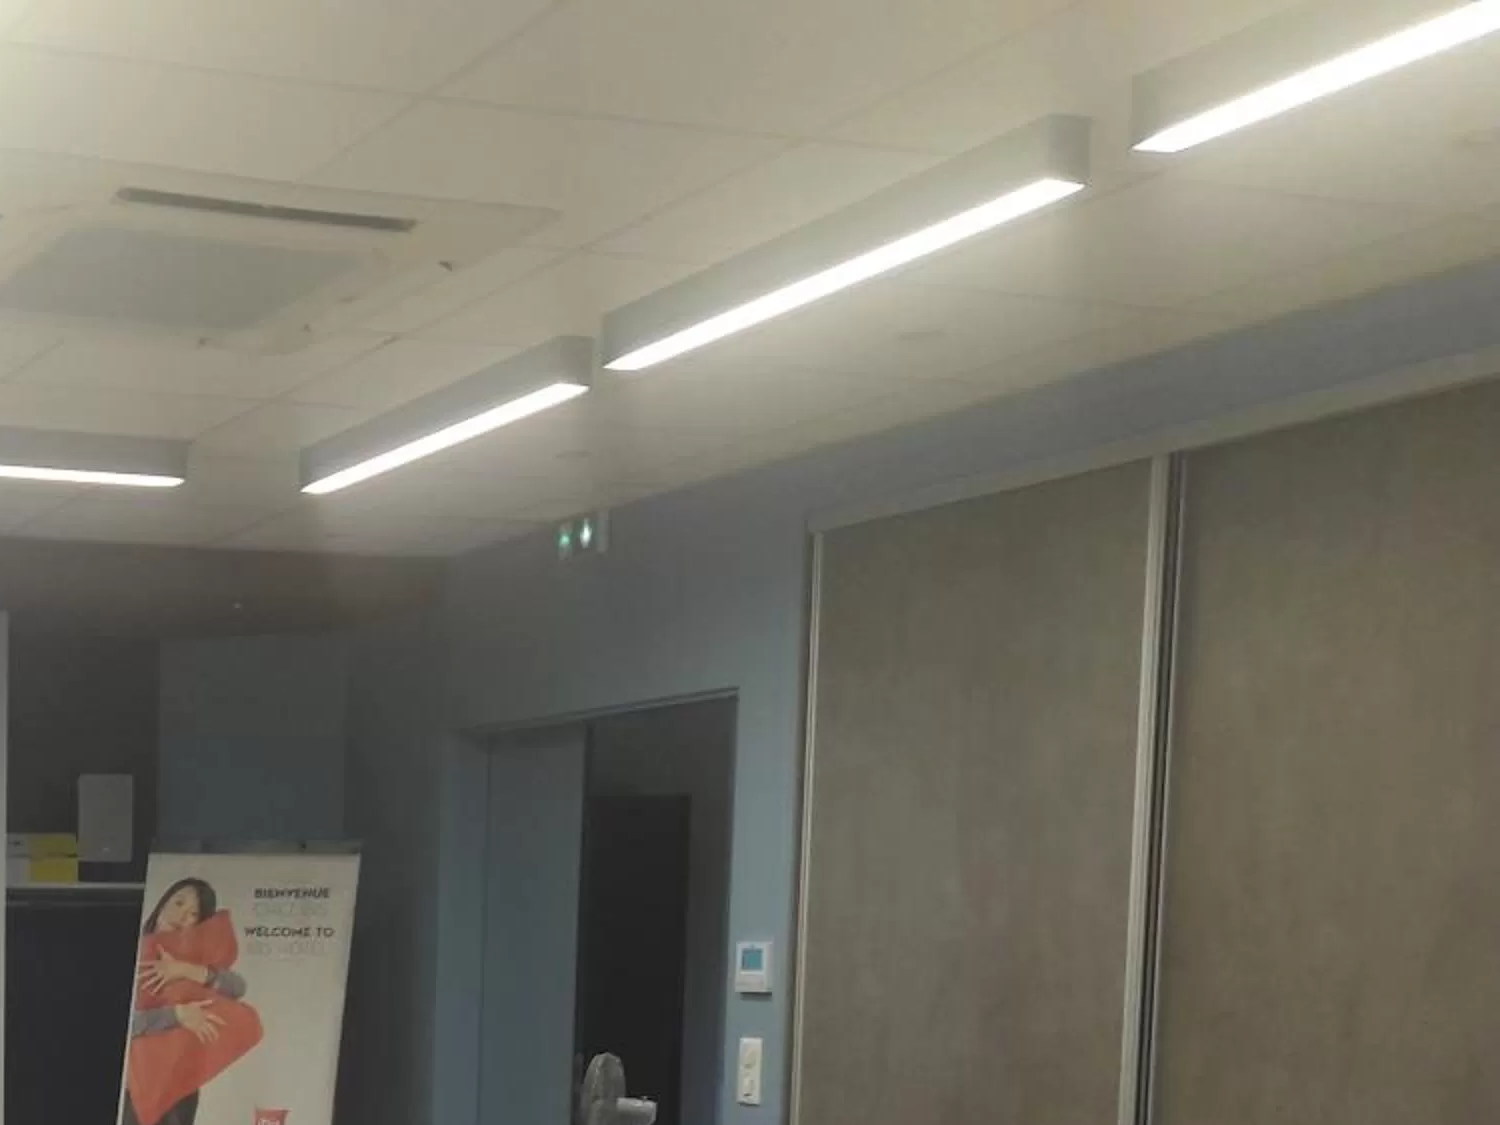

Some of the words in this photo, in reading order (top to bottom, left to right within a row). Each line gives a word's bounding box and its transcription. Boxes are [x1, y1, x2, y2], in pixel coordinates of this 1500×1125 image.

[253, 887, 331, 899] BIENVENUE
[244, 926, 311, 938] WELCOME
[316, 926, 335, 938] TO
